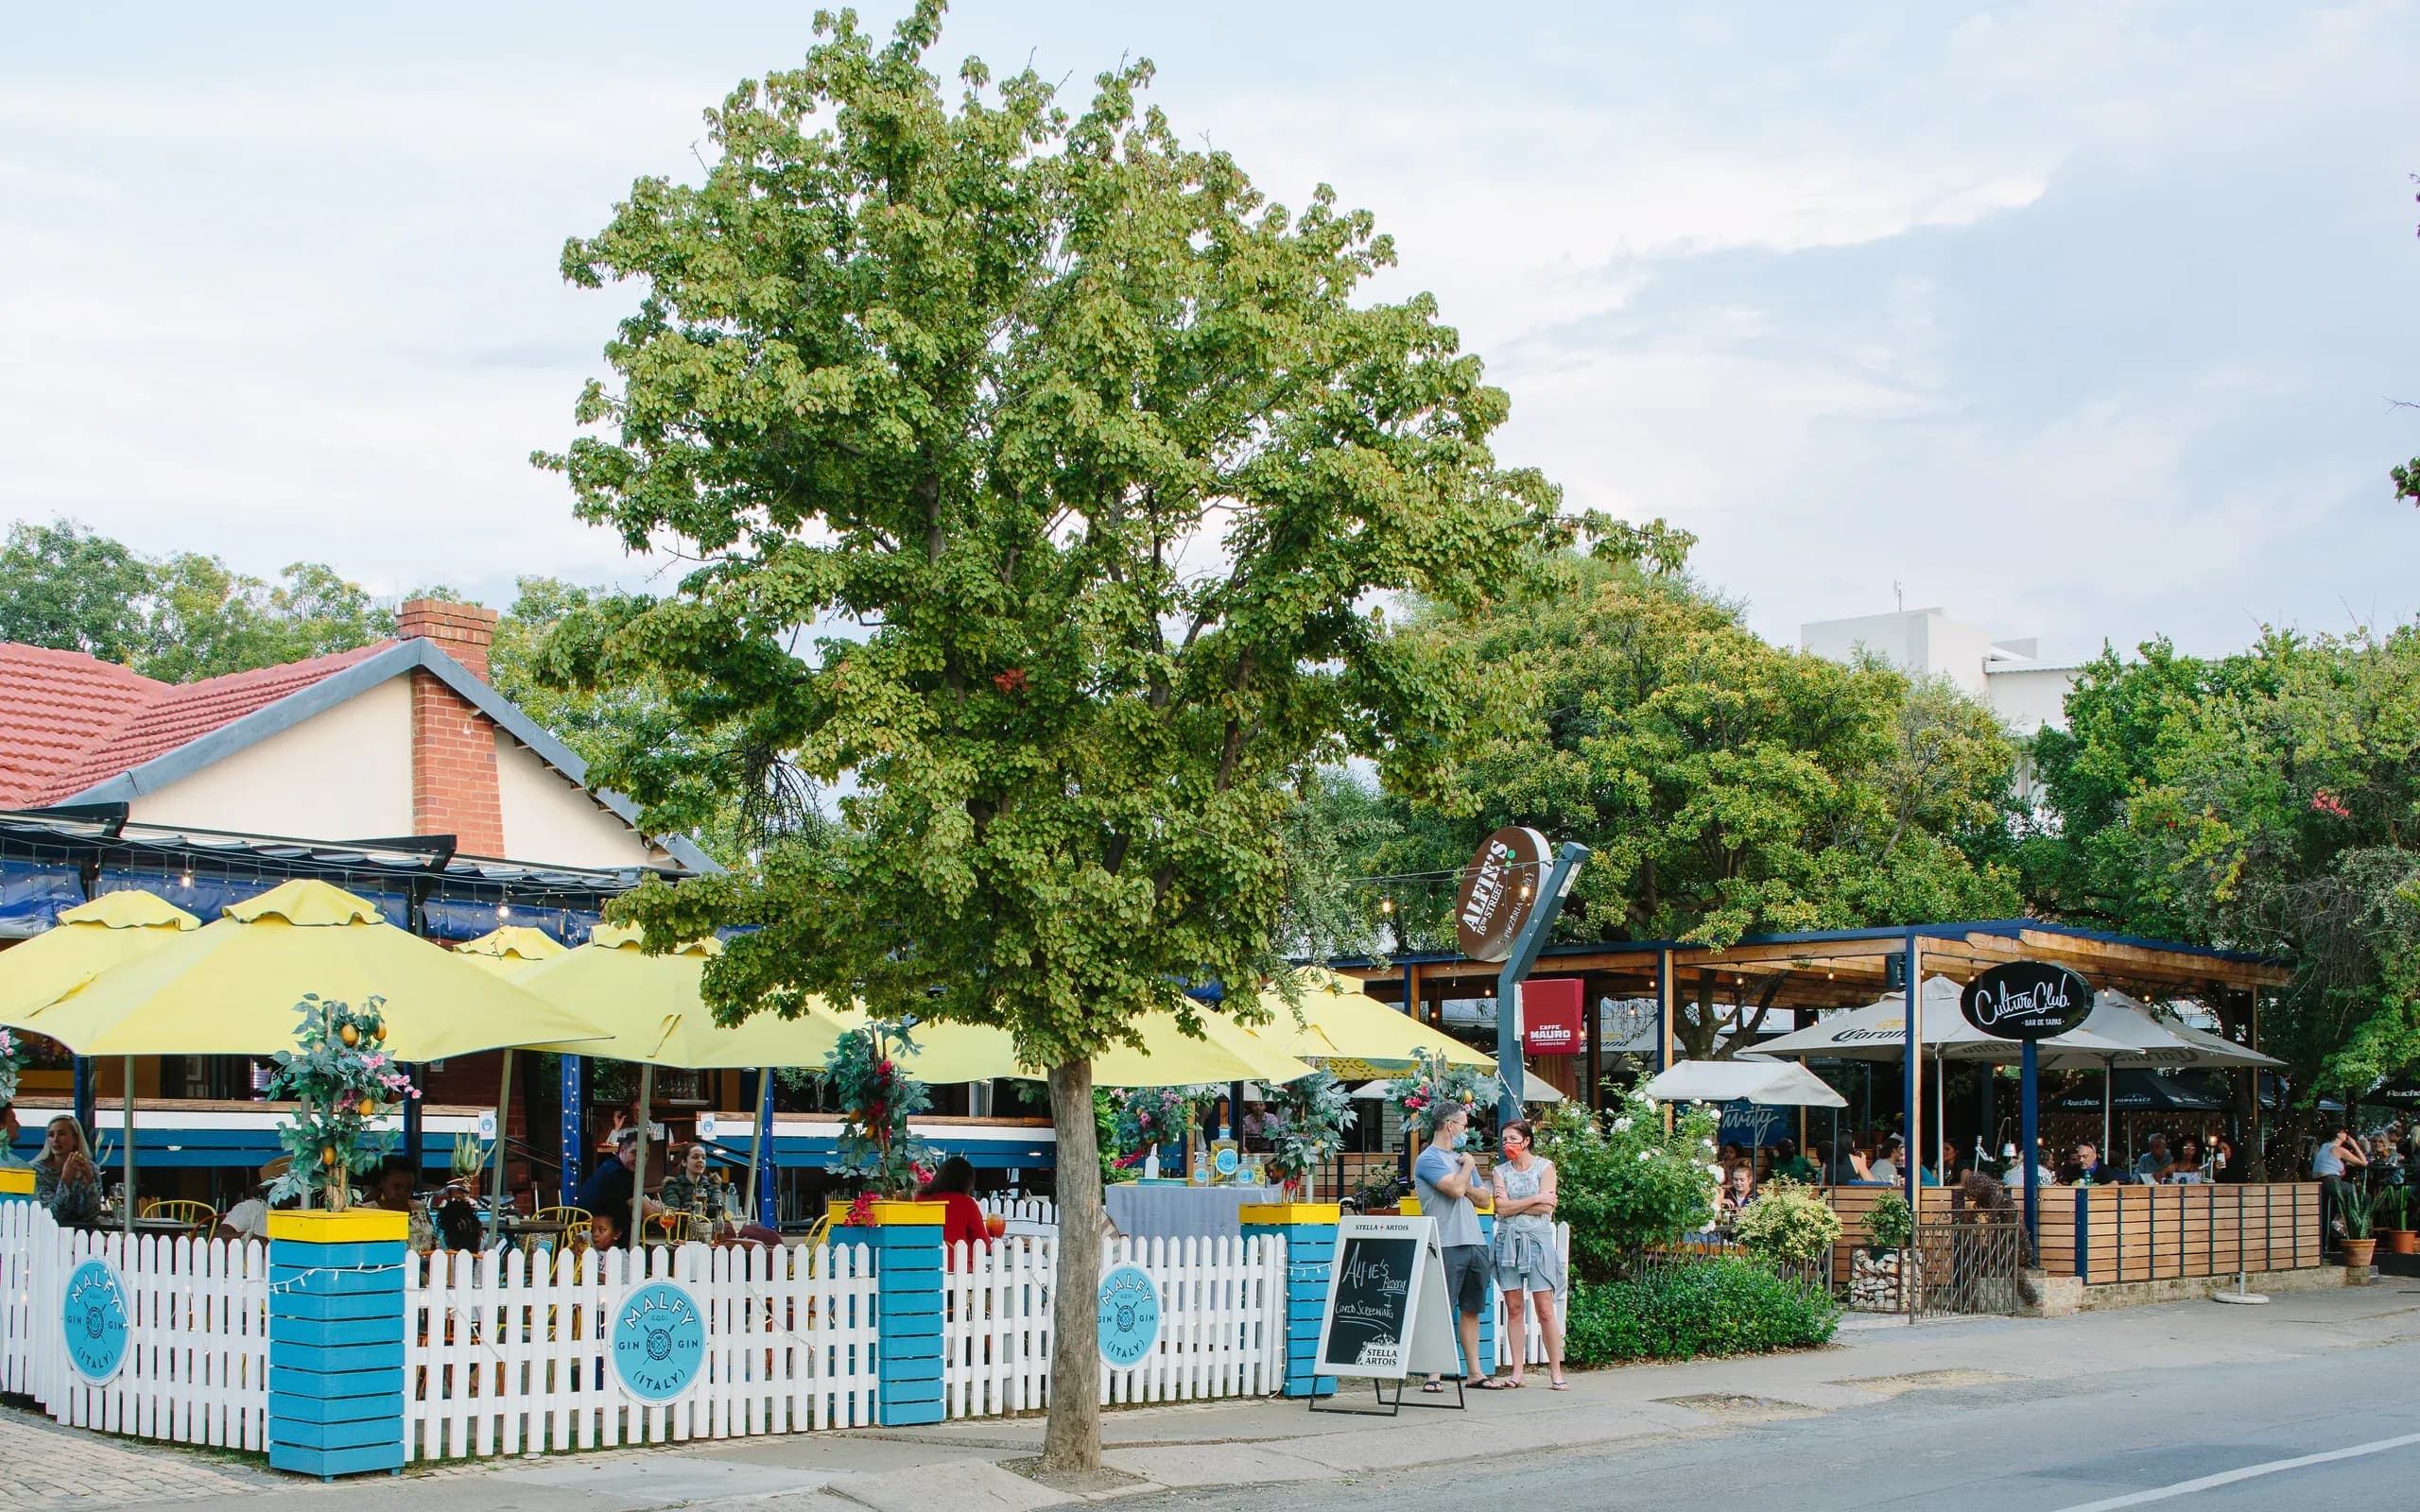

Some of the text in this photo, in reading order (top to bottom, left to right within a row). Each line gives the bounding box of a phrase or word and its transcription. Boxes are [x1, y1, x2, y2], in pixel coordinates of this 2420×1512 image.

[1462, 840, 1508, 933] ALFIE'S
[1484, 881, 1504, 919] STREET
[1504, 902, 1524, 938] PIZZERIA
[1975, 980, 2033, 1025] Culture
[1530, 1029, 1571, 1040] MAURO
[1831, 1028, 1906, 1042] Coron
[1721, 1103, 1779, 1146] tivity
[1100, 1273, 1153, 1307] MALFY
[67, 1314, 82, 1324] GIN
[624, 1291, 697, 1331] MALFY
[108, 1321, 124, 1331] GIN
[618, 1341, 640, 1350] GIN
[678, 1339, 699, 1349] GIN
[1107, 1339, 1145, 1358] (ITALY)
[1367, 1349, 1397, 1358] STELLA
[1366, 1357, 1397, 1366] ARTOIS
[633, 1368, 686, 1391] (ITALY)
